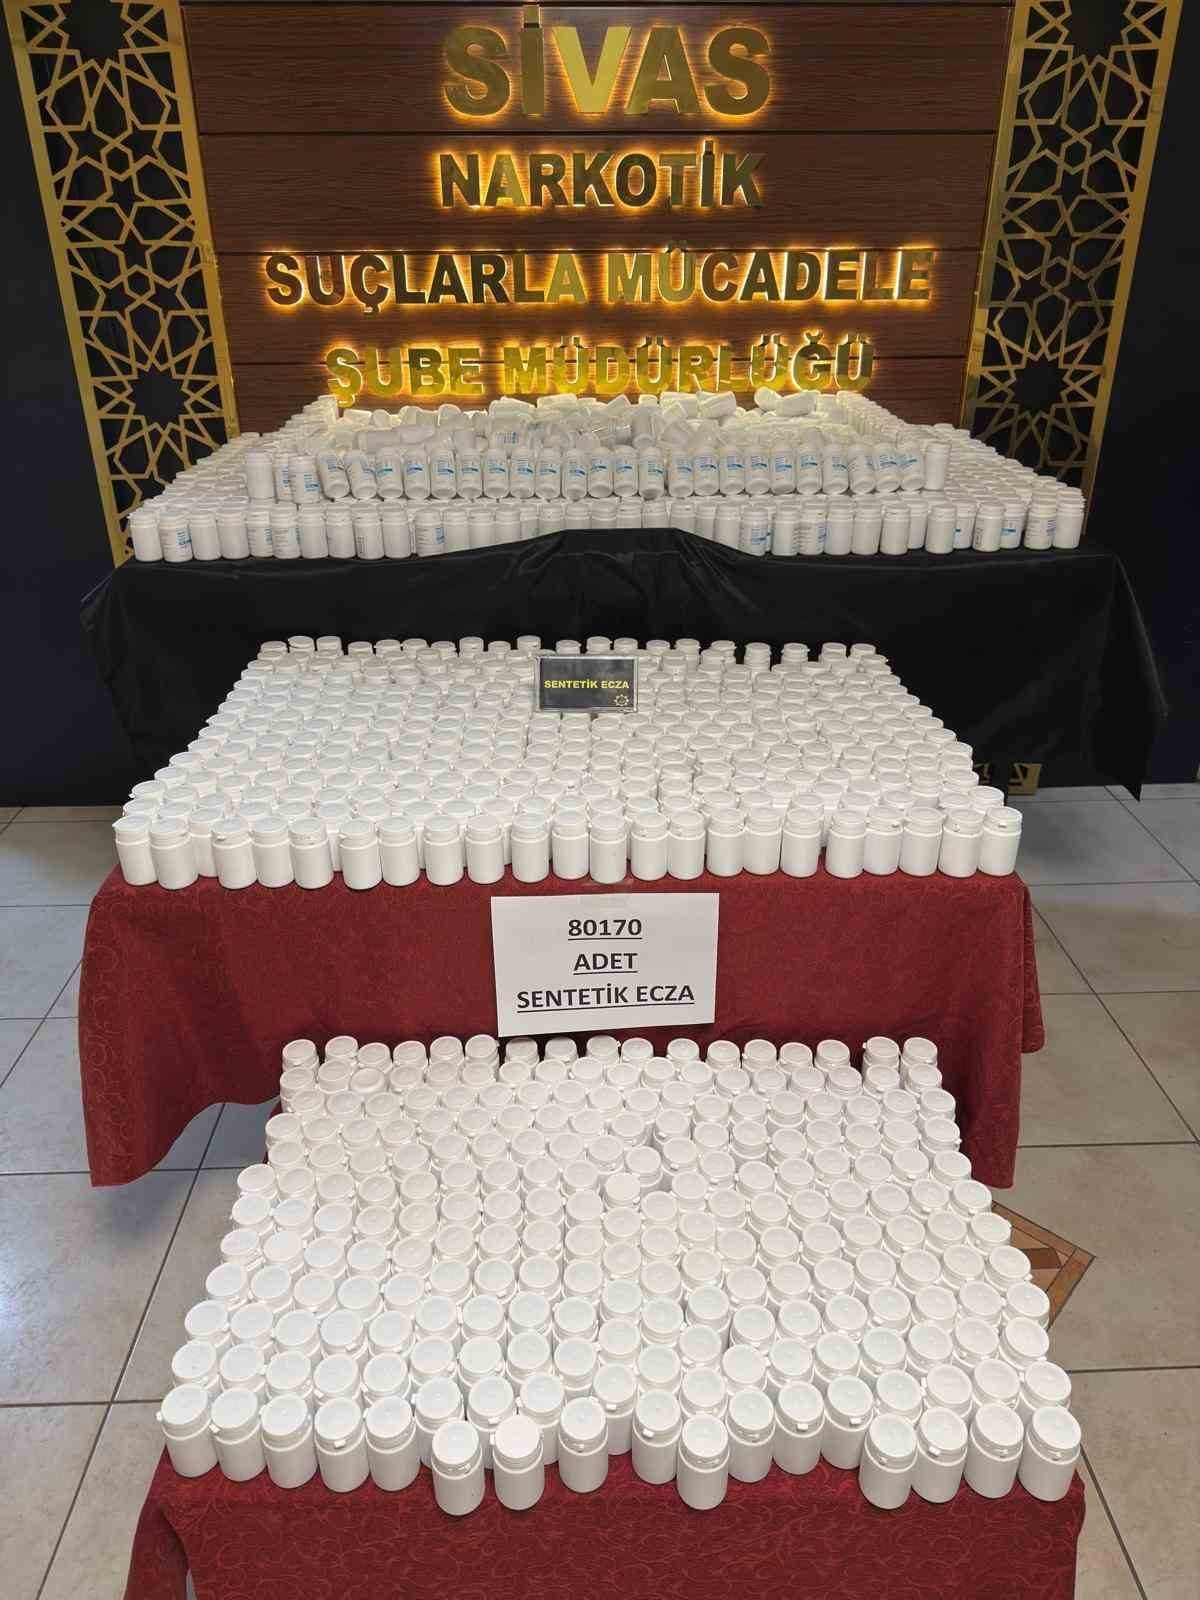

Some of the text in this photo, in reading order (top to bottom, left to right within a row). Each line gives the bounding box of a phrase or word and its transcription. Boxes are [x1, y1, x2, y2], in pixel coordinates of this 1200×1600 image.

[443, 4, 773, 117] SİVAS
[438, 140, 766, 208] NARKOTİK
[265, 241, 935, 314] SUÇLARLA MÜCADELE
[325, 330, 875, 407] ŞUBE MÜDÜRLÜĞÜ
[544, 679, 629, 689] SENTETİK ECZA
[568, 918, 642, 936] 80170
[573, 953, 638, 971] ADET
[517, 984, 695, 1008] SENTETİK ECZA
